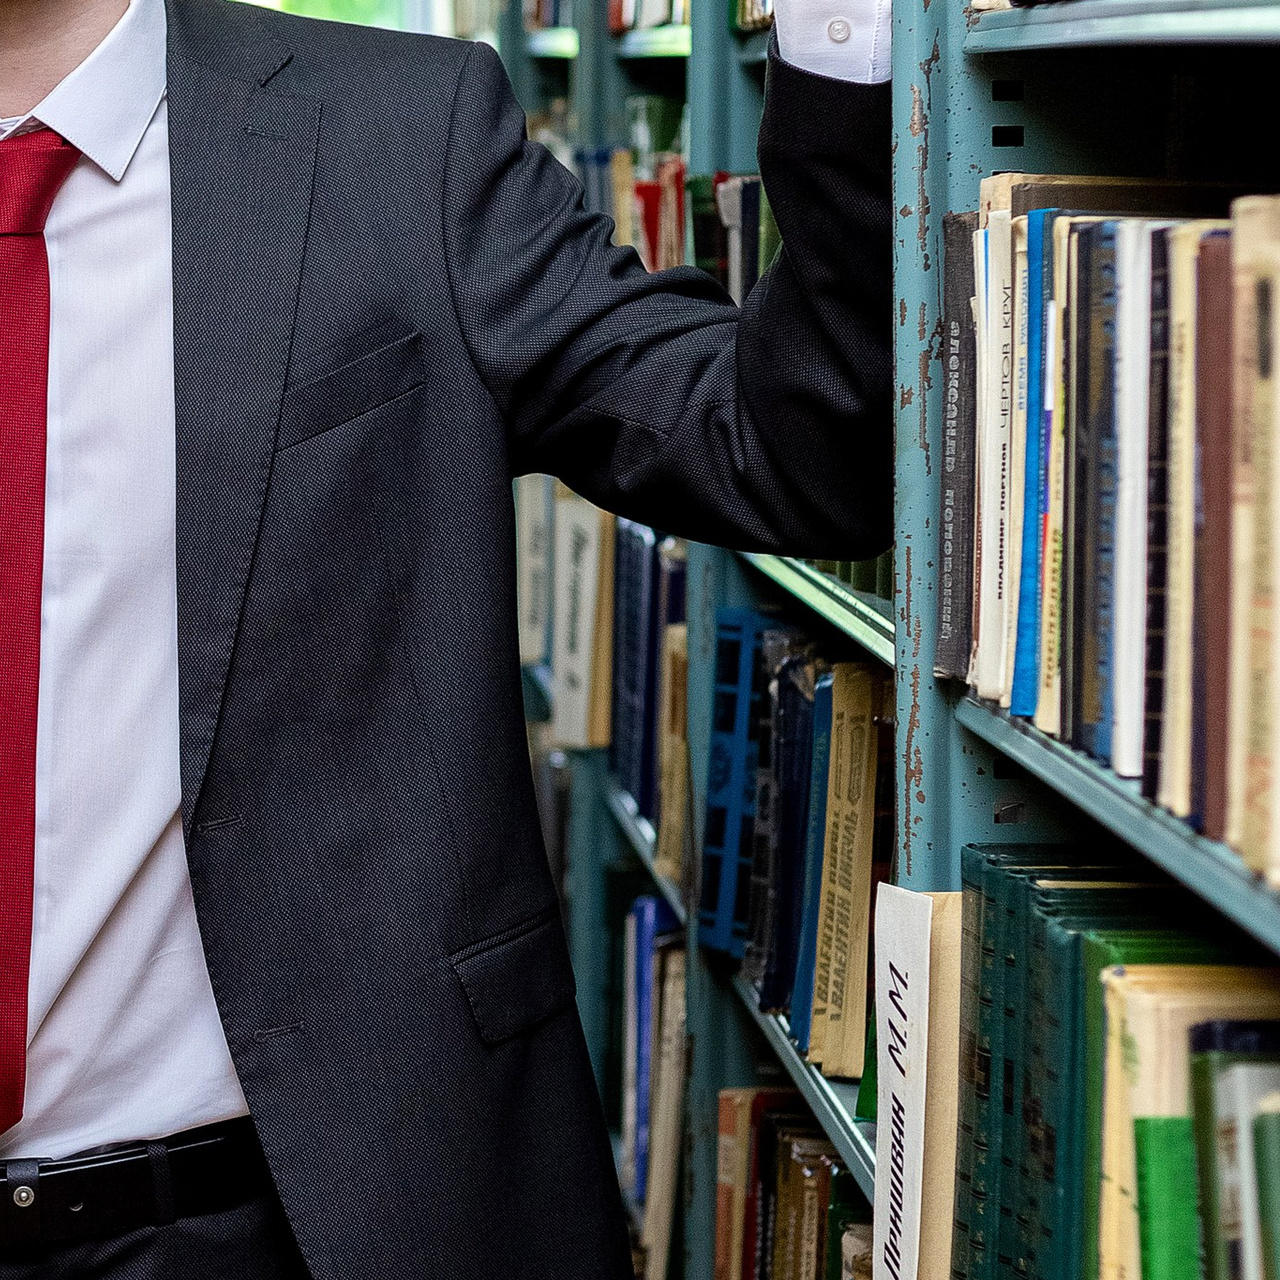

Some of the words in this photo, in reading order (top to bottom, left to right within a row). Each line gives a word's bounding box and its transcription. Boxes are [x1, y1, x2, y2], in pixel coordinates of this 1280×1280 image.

[1002, 277, 1012, 329] КРУГ
[1000, 342, 1011, 429] ЧЕРТОВ
[1000, 442, 1008, 511] ПОРТНОВ
[997, 518, 1005, 600] ВЛАДИМИР
[837, 810, 858, 892] ПИКУЛЬ
[830, 896, 851, 1009] ВАЛЕНТИН
